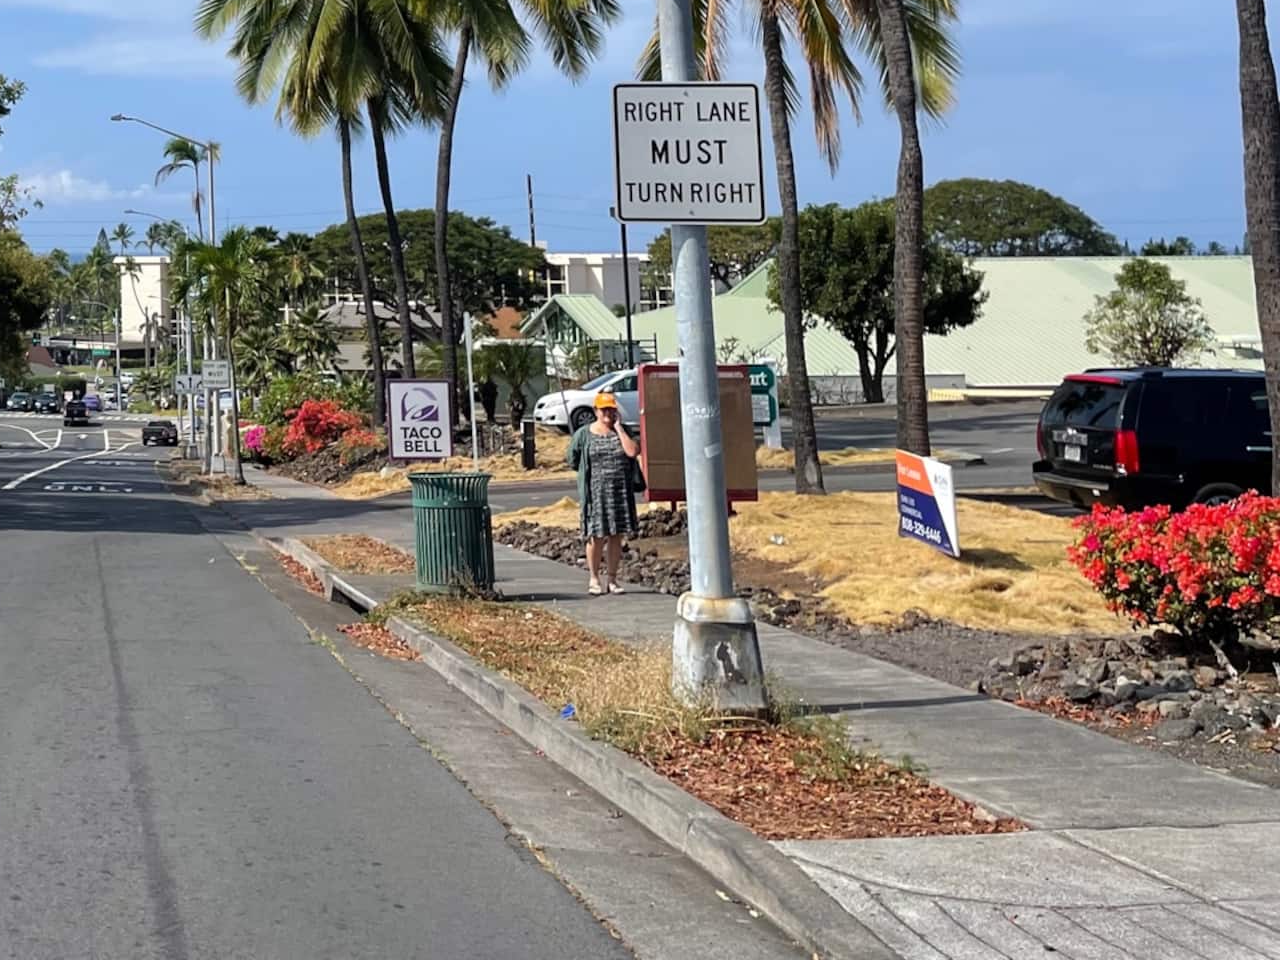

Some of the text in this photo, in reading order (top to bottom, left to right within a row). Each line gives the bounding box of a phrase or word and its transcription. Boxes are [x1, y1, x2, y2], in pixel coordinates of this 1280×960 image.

[624, 102, 750, 122] RIGHT LANE
[651, 139, 728, 164] MUST
[625, 182, 755, 203] TURN RIGHT
[400, 427, 442, 439] TACO
[404, 440, 442, 453] BELL
[43, 481, 133, 493] ONLY
